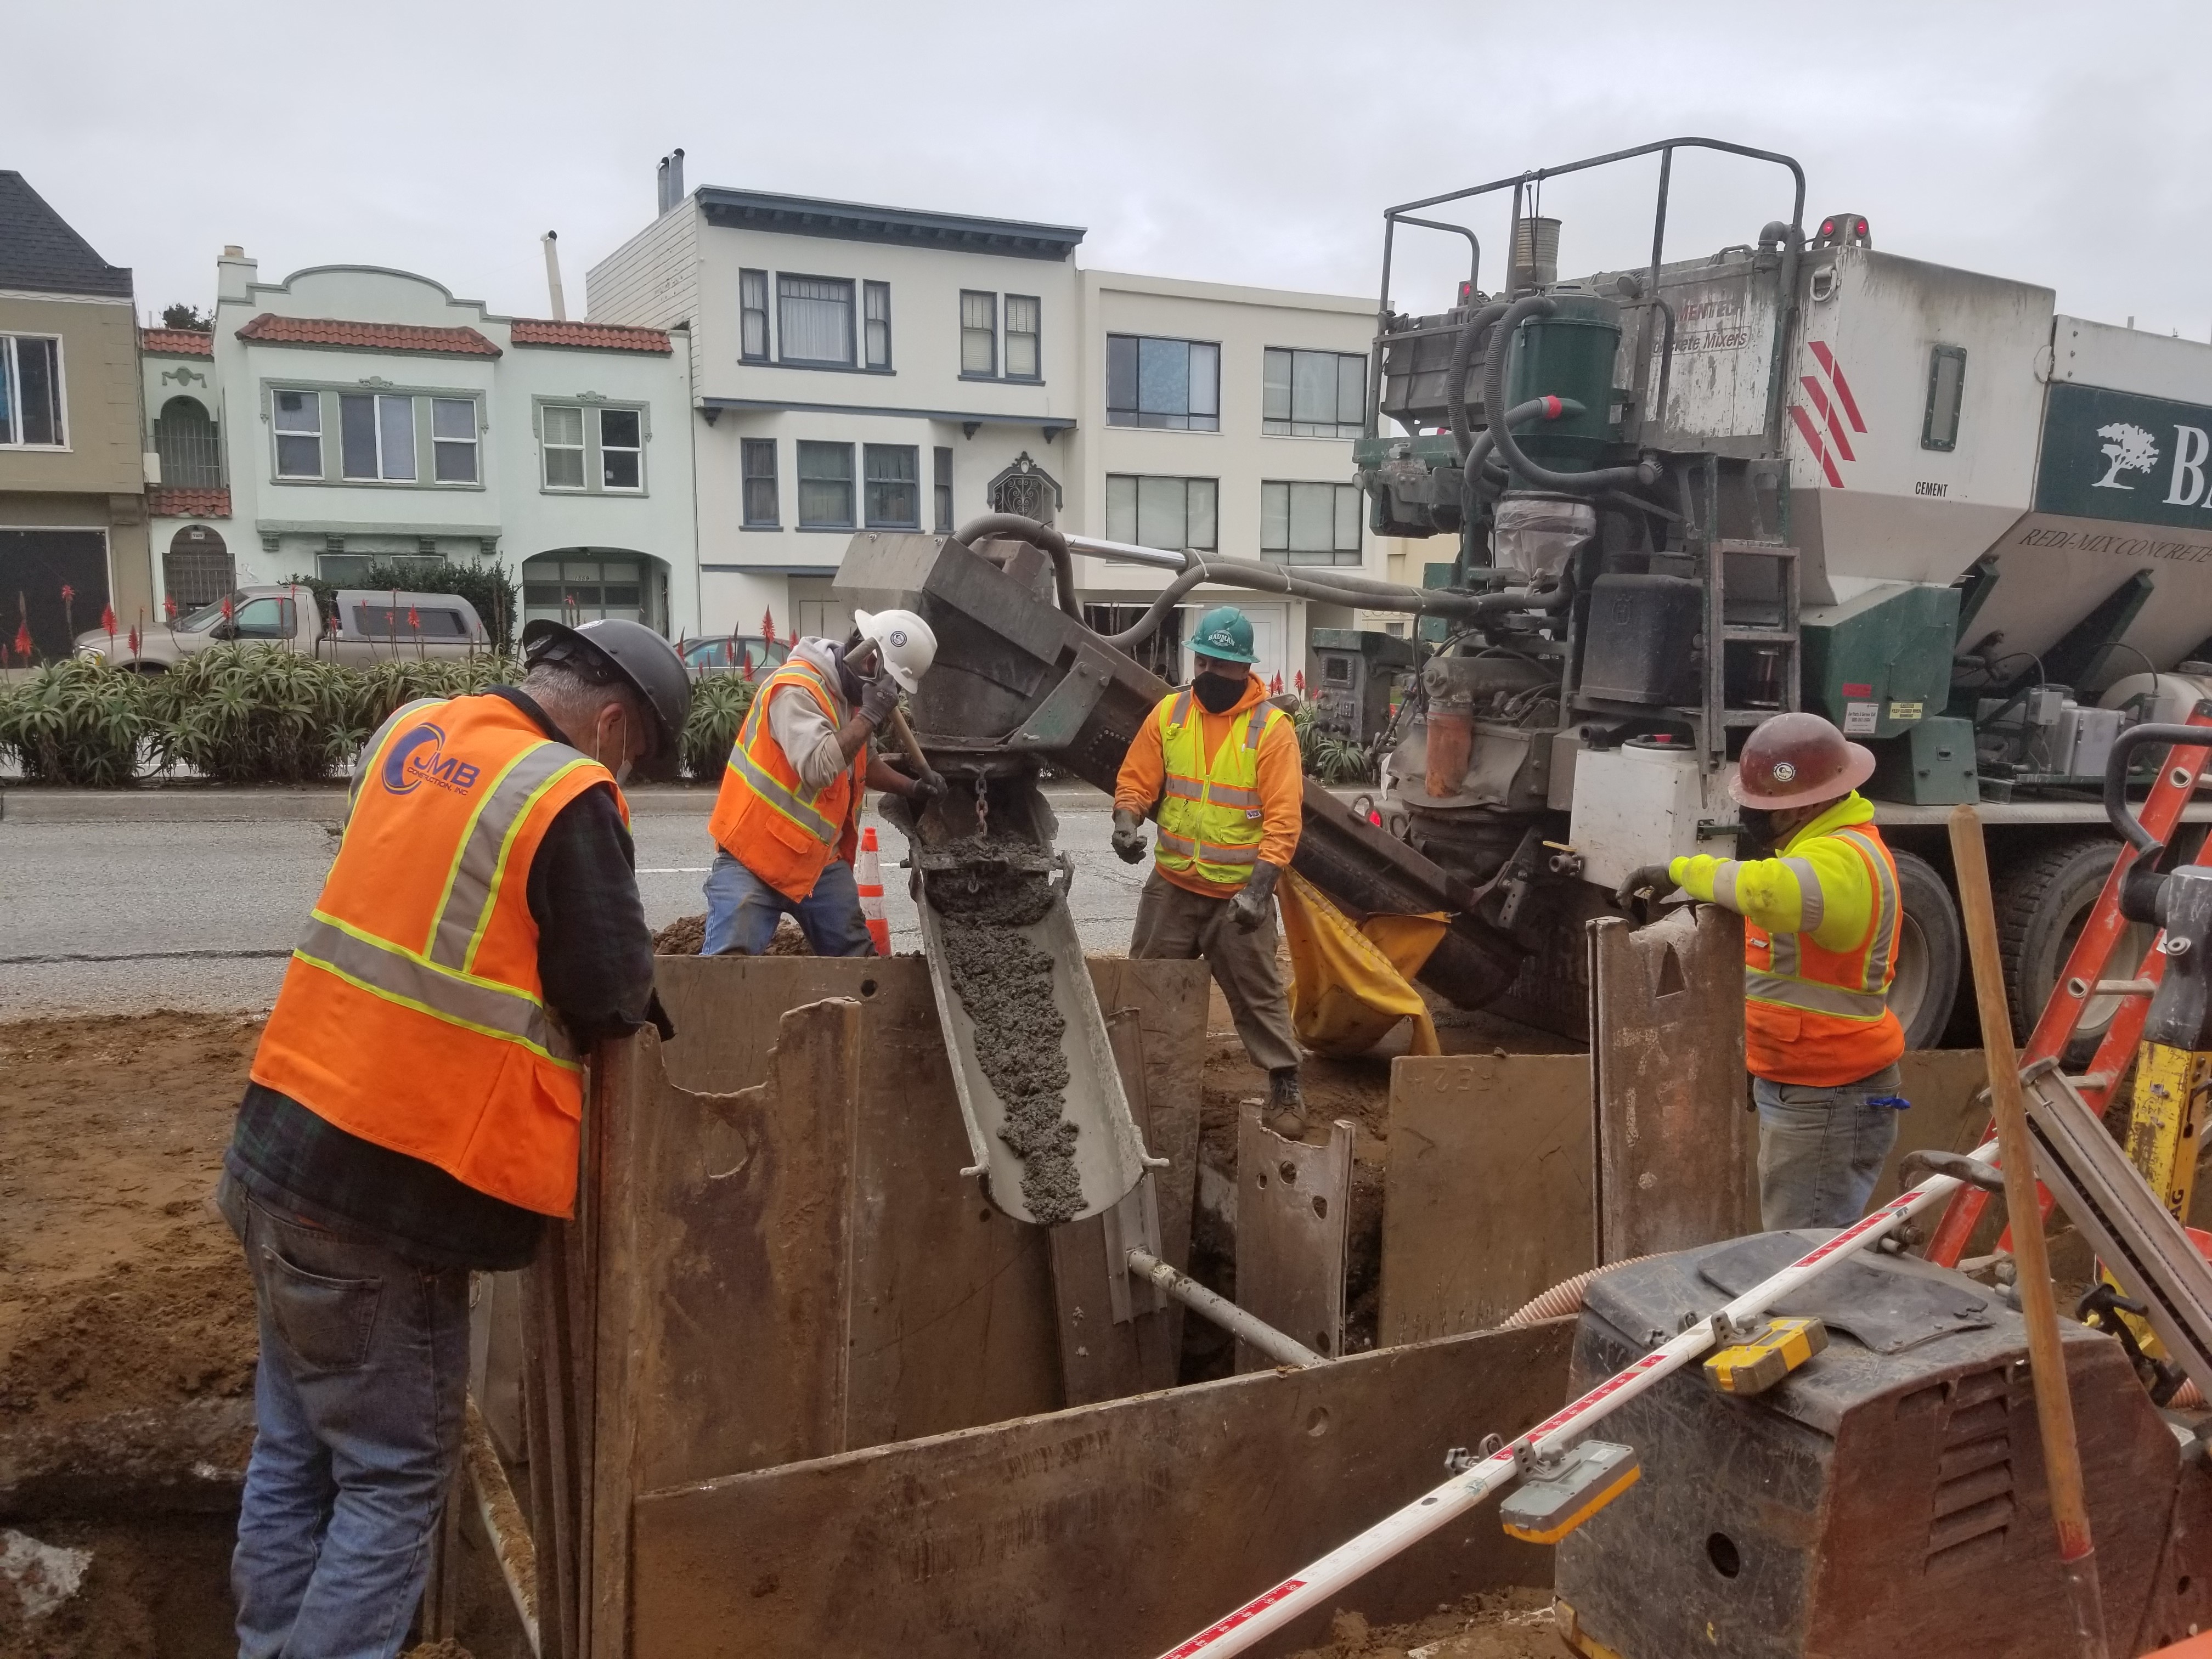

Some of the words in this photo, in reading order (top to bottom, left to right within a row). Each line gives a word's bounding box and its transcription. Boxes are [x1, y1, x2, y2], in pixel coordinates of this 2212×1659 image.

[1675, 300, 1745, 321] MENTECH
[1703, 332, 1747, 349] Mixers
[1915, 481, 1948, 497] CEMENT
[2018, 529, 2118, 552] REDI-MIX
[2115, 539, 2212, 562] CONCRETE
[1208, 634, 1235, 646] BAUMAN
[407, 766, 452, 792] CONSTRUCTION,
[454, 787, 468, 795] INC
[414, 752, 481, 788] JMB
